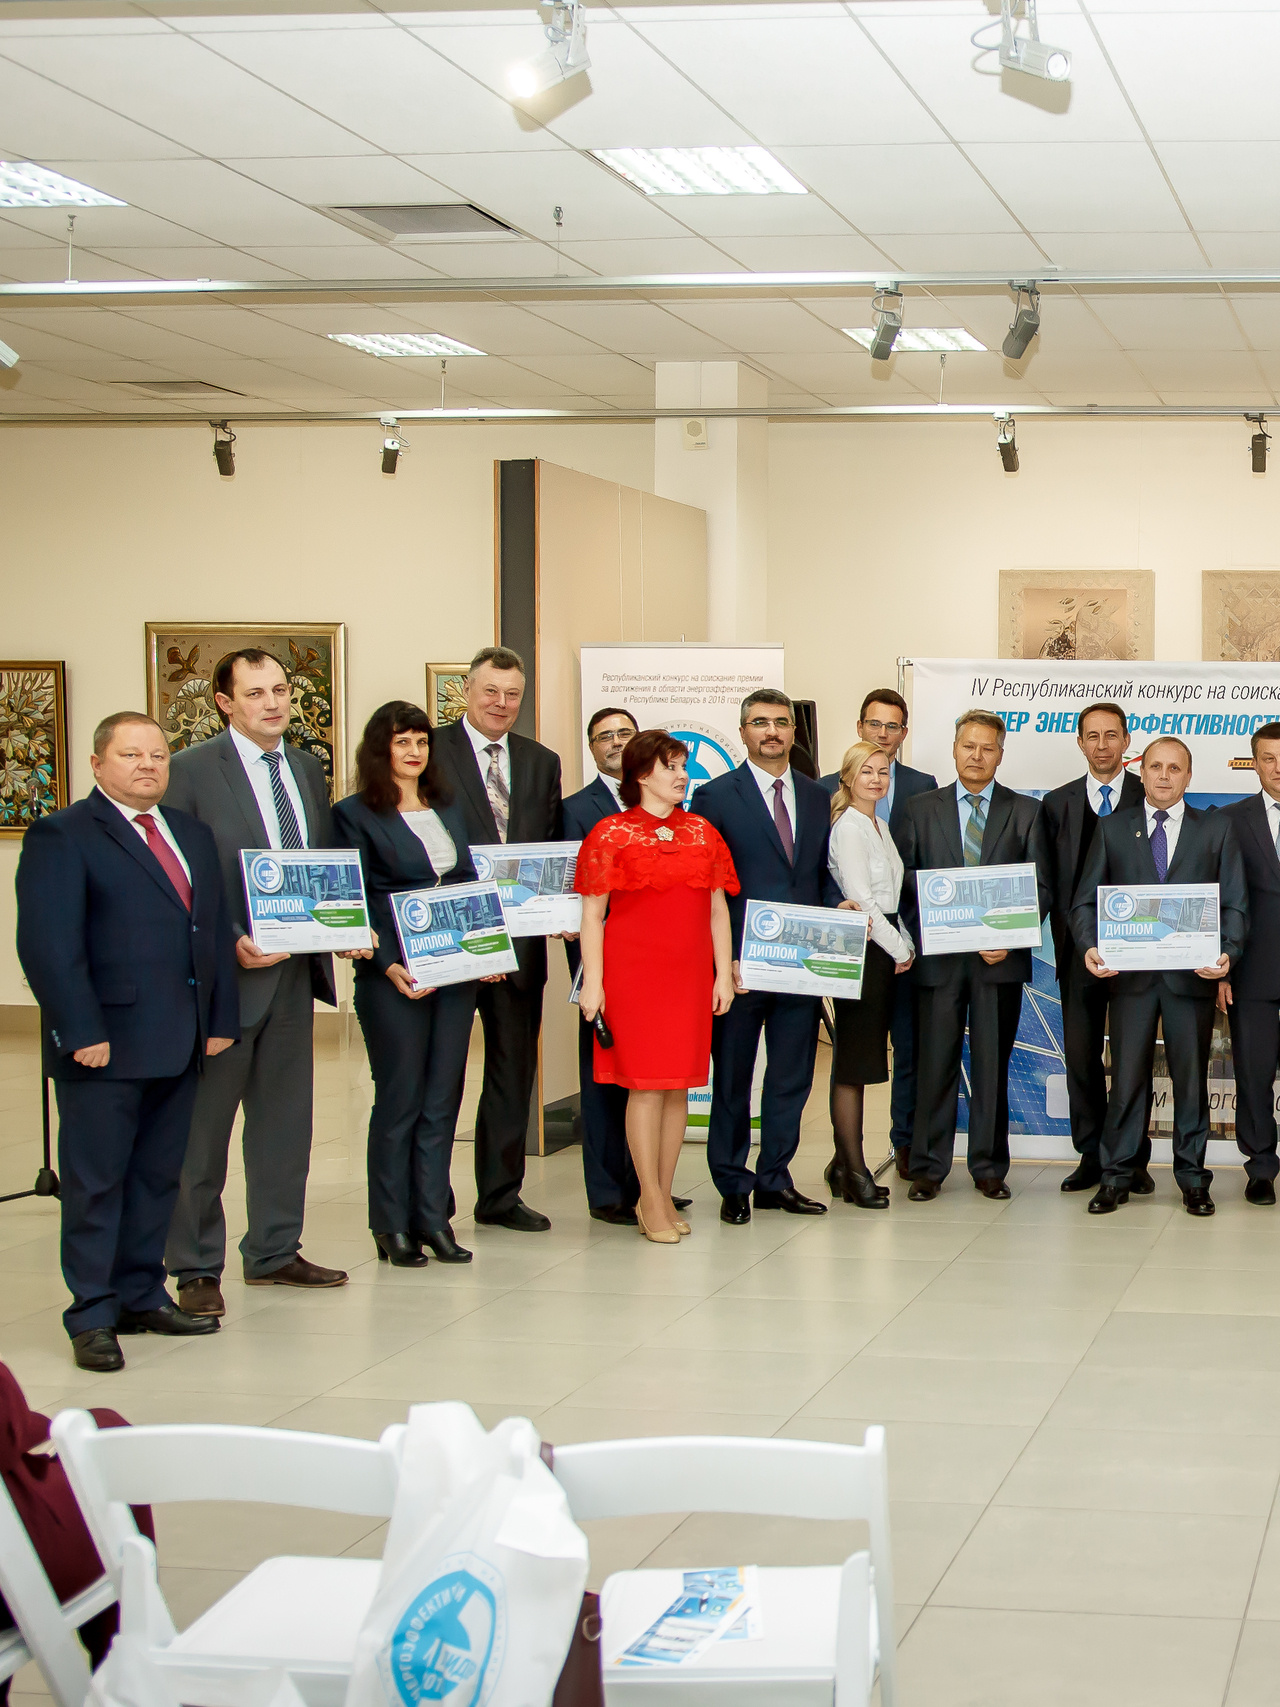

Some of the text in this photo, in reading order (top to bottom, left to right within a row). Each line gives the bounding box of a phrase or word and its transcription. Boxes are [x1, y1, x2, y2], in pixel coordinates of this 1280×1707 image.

[602, 673, 660, 683] Республиканский
[662, 674, 689, 683] конкурс
[737, 675, 764, 683] премии
[658, 684, 686, 693] области
[686, 685, 765, 694] энергоэффективнос
[971, 678, 989, 697] IV
[992, 678, 1134, 701] Республиканский
[1137, 684, 1203, 703] конкурс
[1207, 684, 1226, 700] на
[629, 694, 668, 705] Республике
[670, 695, 700, 705] Беларусь
[708, 695, 725, 704] 2018
[726, 696, 742, 705] году
[257, 899, 305, 917] ДИПЛОМ
[927, 908, 975, 924] ДИПЛОМ
[1105, 923, 1153, 938] ДИПЛОМ
[410, 932, 455, 955] ДИПЛОМ
[747, 943, 798, 960] ДИПЛОМ
